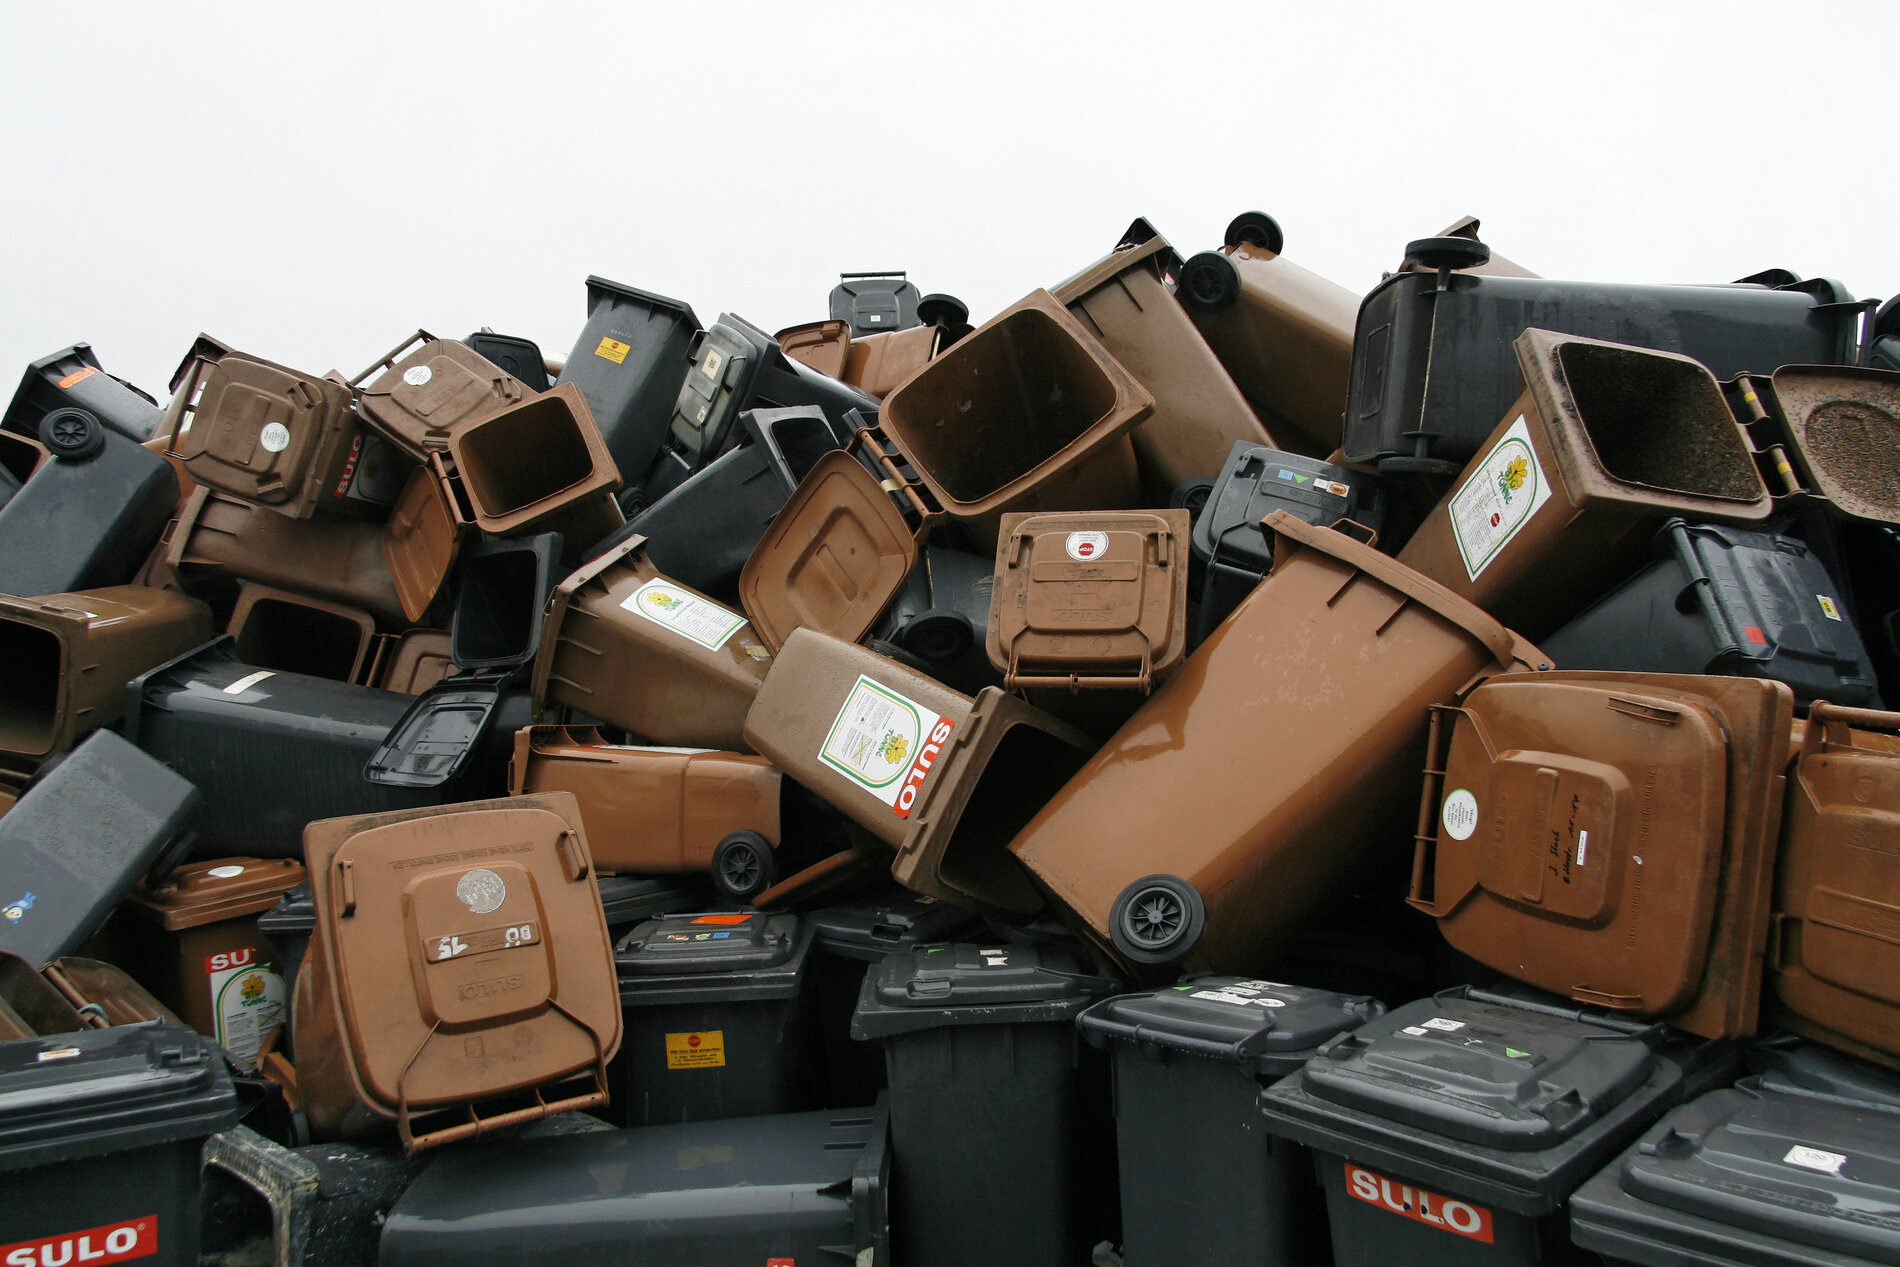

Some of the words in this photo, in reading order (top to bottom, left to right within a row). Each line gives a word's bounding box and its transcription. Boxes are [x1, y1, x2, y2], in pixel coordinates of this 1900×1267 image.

[337, 434, 362, 494] SULO
[899, 722, 951, 811] SULO
[210, 948, 251, 970] SU
[459, 975, 522, 1000] SULO
[1352, 1169, 1481, 1233] SULO
